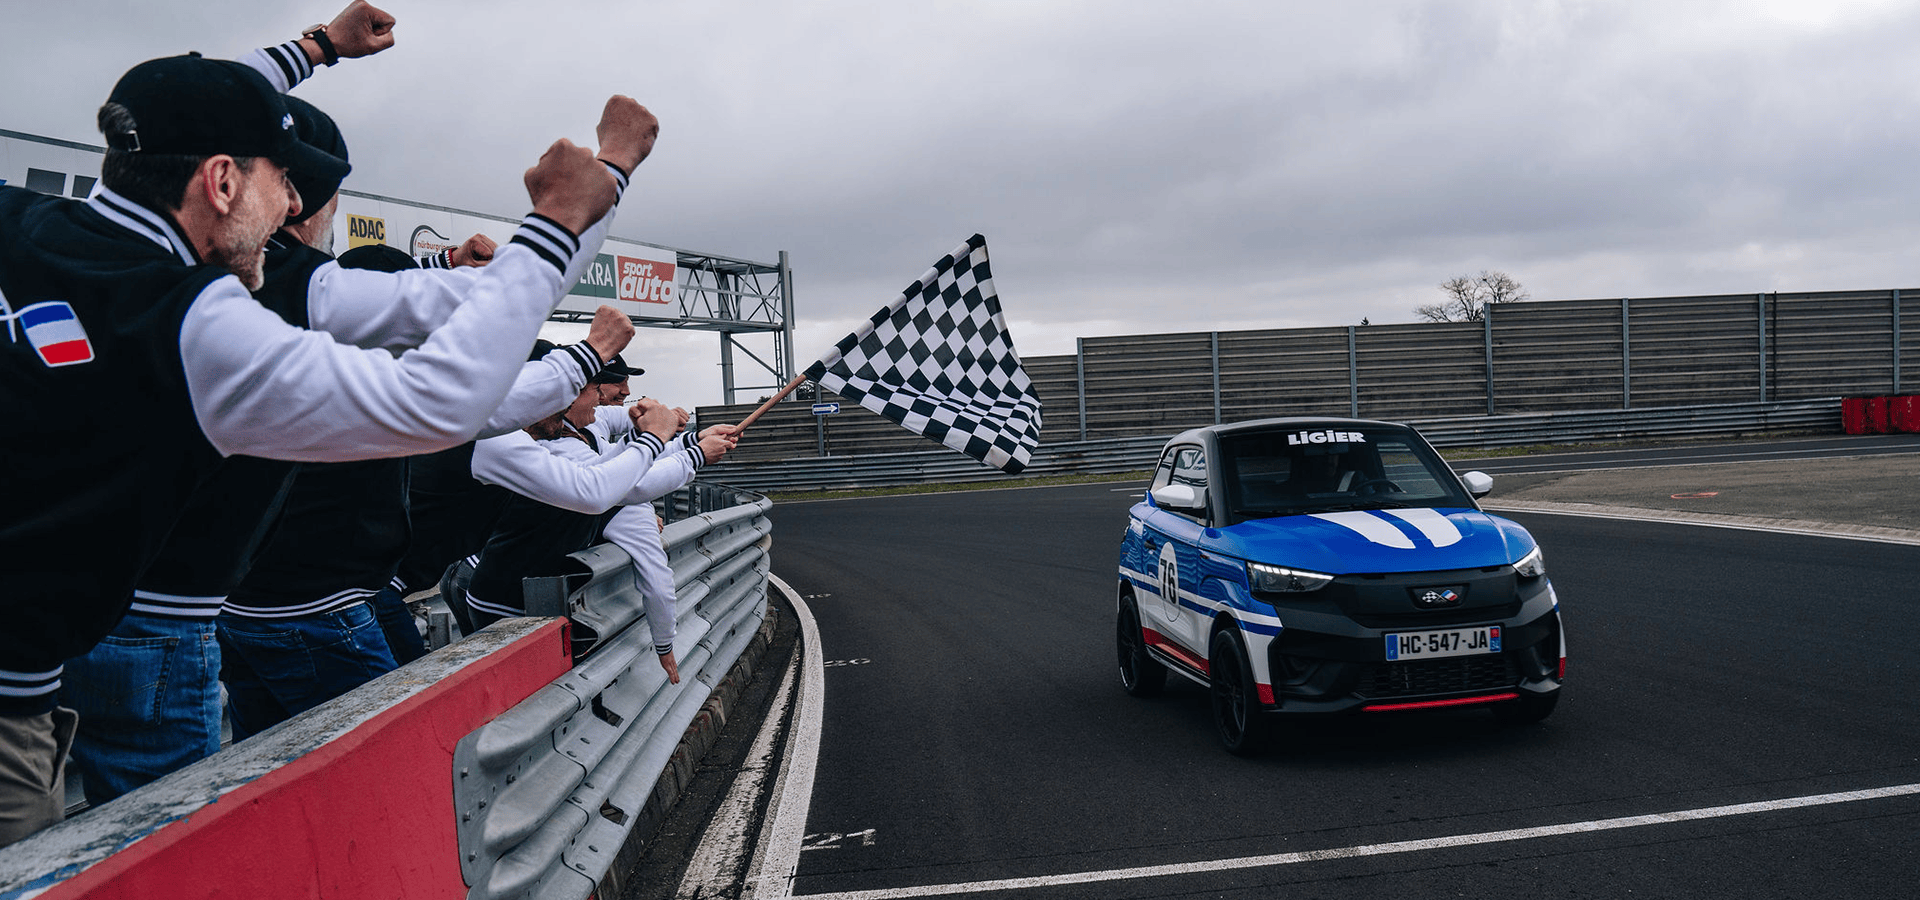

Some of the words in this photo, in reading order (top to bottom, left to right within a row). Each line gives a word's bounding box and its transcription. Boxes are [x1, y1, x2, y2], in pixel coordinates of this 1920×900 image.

[350, 217, 385, 241] ADAC
[623, 262, 653, 277] sport
[620, 275, 676, 303] auto
[1160, 558, 1177, 605] 76
[1400, 630, 1488, 655] HC-547-JA
